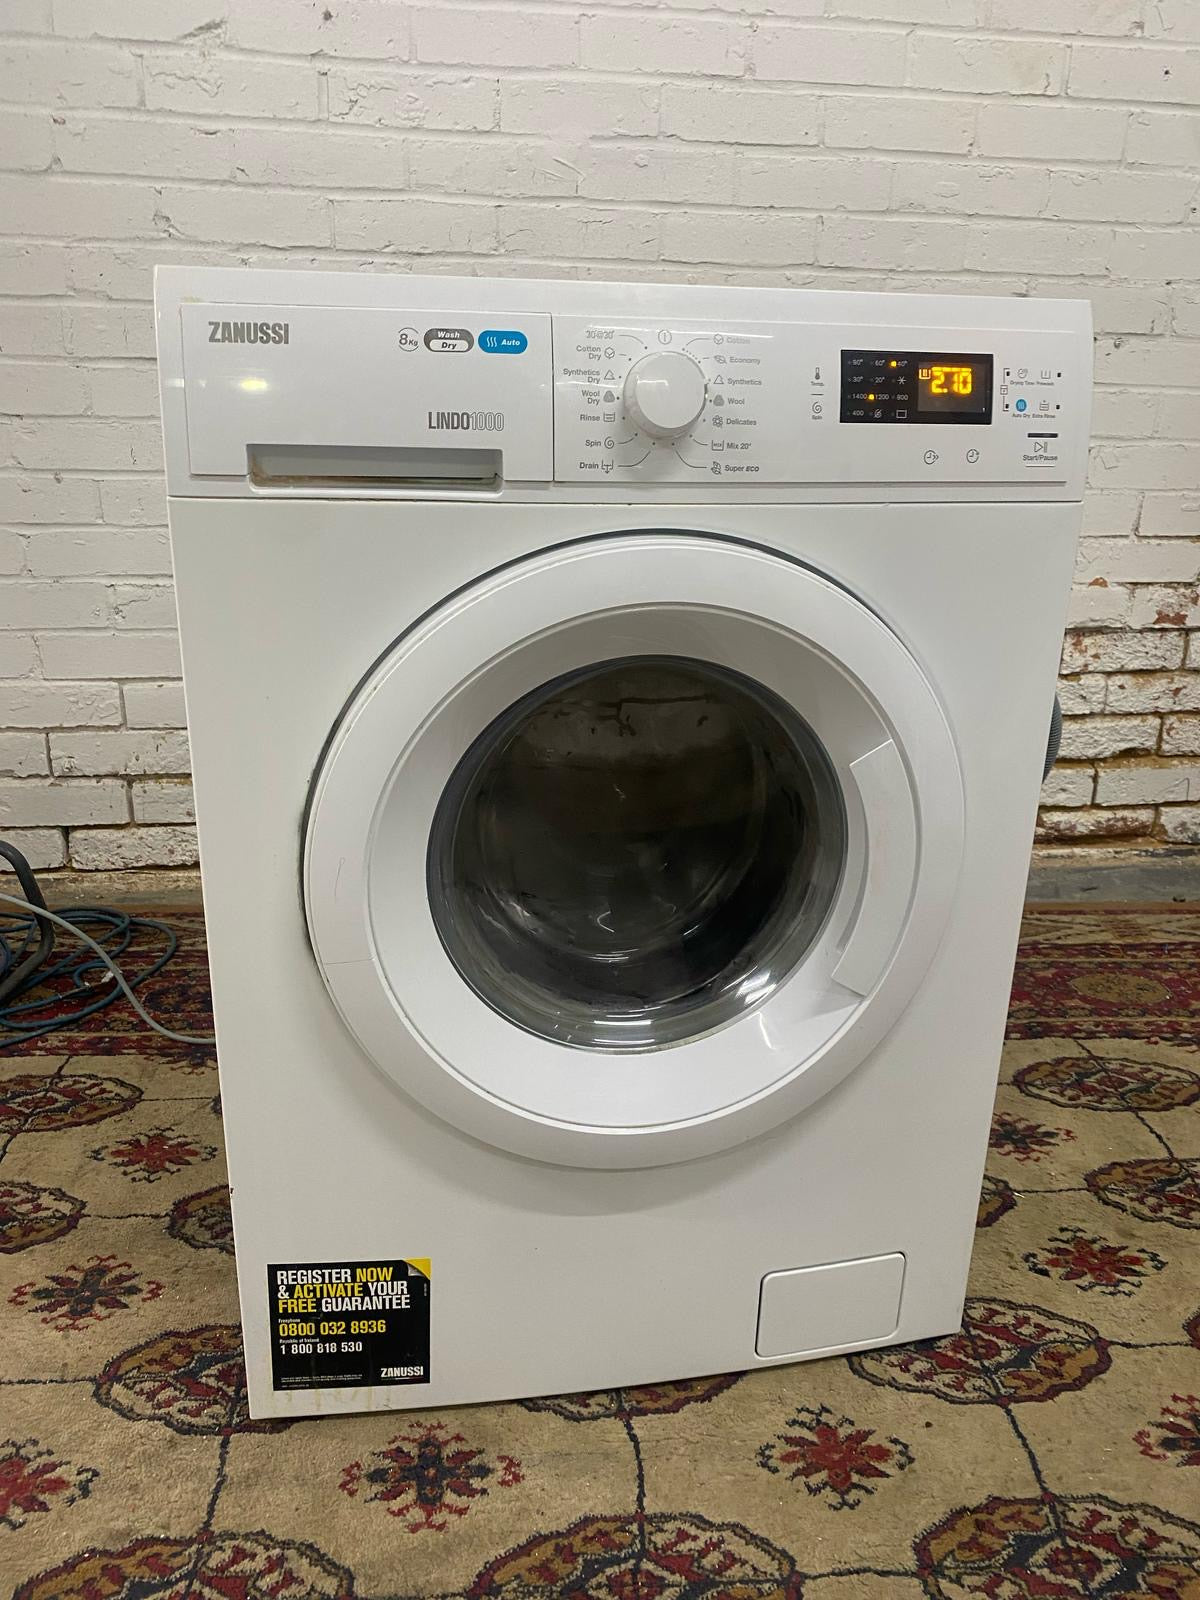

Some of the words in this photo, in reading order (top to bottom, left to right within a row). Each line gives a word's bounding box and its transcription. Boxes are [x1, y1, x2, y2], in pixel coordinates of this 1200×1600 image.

[208, 321, 290, 345] ZANUSSI
[441, 342, 457, 350] Dry
[729, 357, 760, 365] Economy
[563, 368, 600, 376] Synthetics
[727, 378, 762, 386] Synthetics
[428, 411, 505, 431] LINDO1000
[726, 418, 757, 426] Delicates
[585, 440, 601, 448] Spin
[724, 465, 744, 473] Super
[277, 1269, 351, 1285] REGISTER
[356, 1267, 393, 1282] NOW
[278, 1285, 290, 1299] &
[294, 1282, 363, 1298] ACTIVATE
[368, 1281, 408, 1296] YOUR
[278, 1299, 317, 1313] FREE
[322, 1295, 410, 1312] GUARANTEE
[279, 1323, 315, 1336] 0800
[320, 1321, 346, 1335] 032
[350, 1320, 386, 1334] 8936
[280, 1345, 286, 1355] 1
[291, 1344, 313, 1354] 800
[317, 1343, 337, 1353] 818
[341, 1342, 362, 1352] 530
[381, 1366, 424, 1378] ZANUSSI
